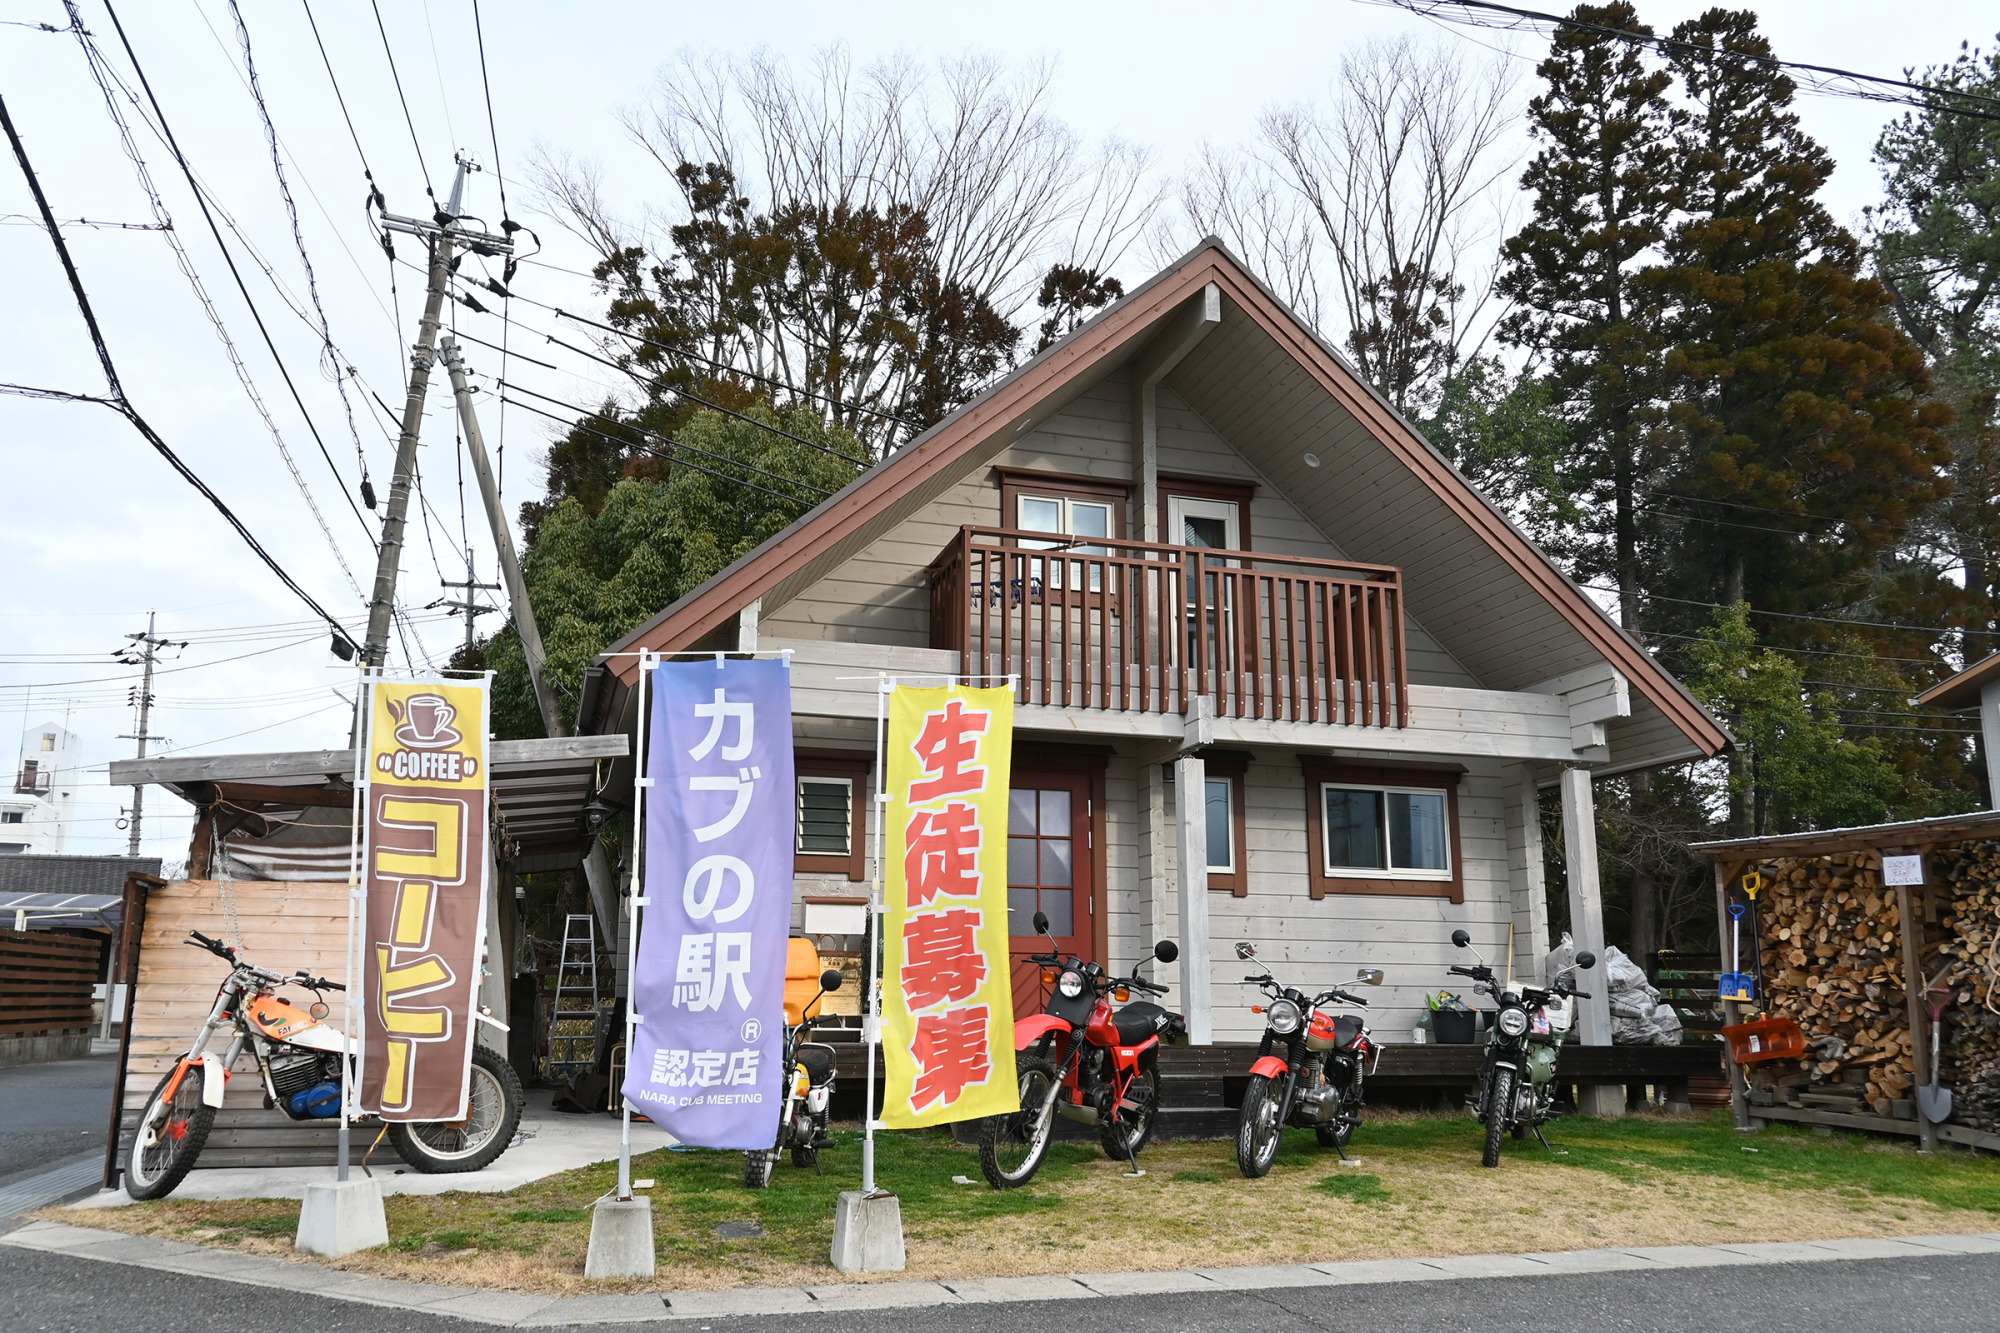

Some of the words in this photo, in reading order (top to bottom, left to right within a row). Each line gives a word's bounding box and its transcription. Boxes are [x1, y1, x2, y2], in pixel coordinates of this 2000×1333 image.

[394, 751, 460, 780] COFFEE
[672, 687, 763, 1012] カブの駅
[376, 796, 466, 1109] コーヒー
[900, 699, 991, 1112] 生徒募集
[639, 1089, 676, 1106] NARA
[679, 1096, 704, 1107] CUB
[706, 1093, 763, 1105] MEETING
[650, 1048, 761, 1088] 認定店
